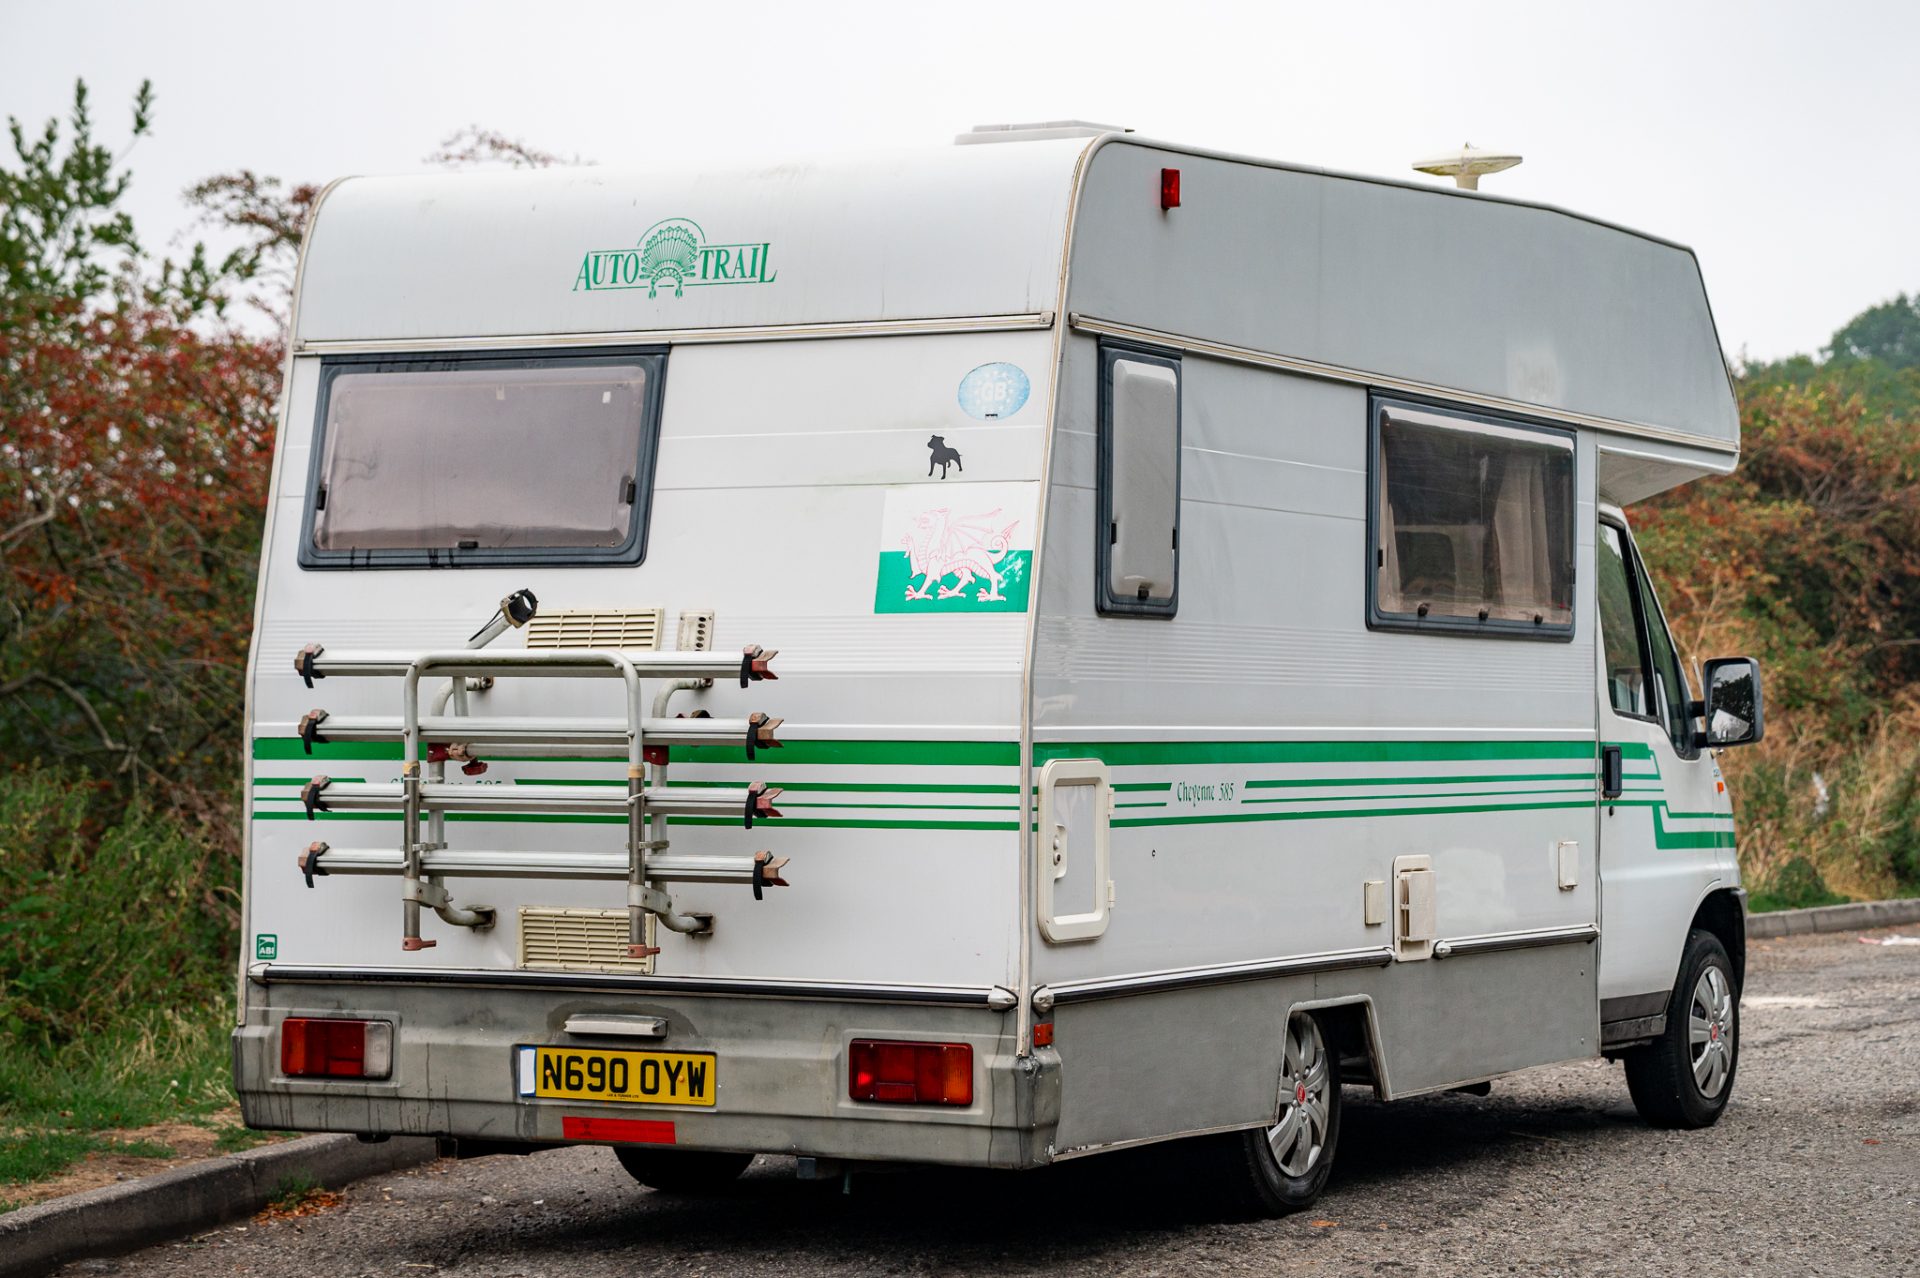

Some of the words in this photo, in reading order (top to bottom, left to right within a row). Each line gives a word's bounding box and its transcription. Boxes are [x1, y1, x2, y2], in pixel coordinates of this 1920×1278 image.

[572, 251, 640, 292] AUTO
[698, 242, 778, 284] TRAIL
[981, 382, 1007, 401] GB
[1177, 781, 1215, 807] Cheyenne
[1219, 782, 1234, 801] 585
[543, 1054, 628, 1094] N690
[640, 1059, 707, 1098] OYW
